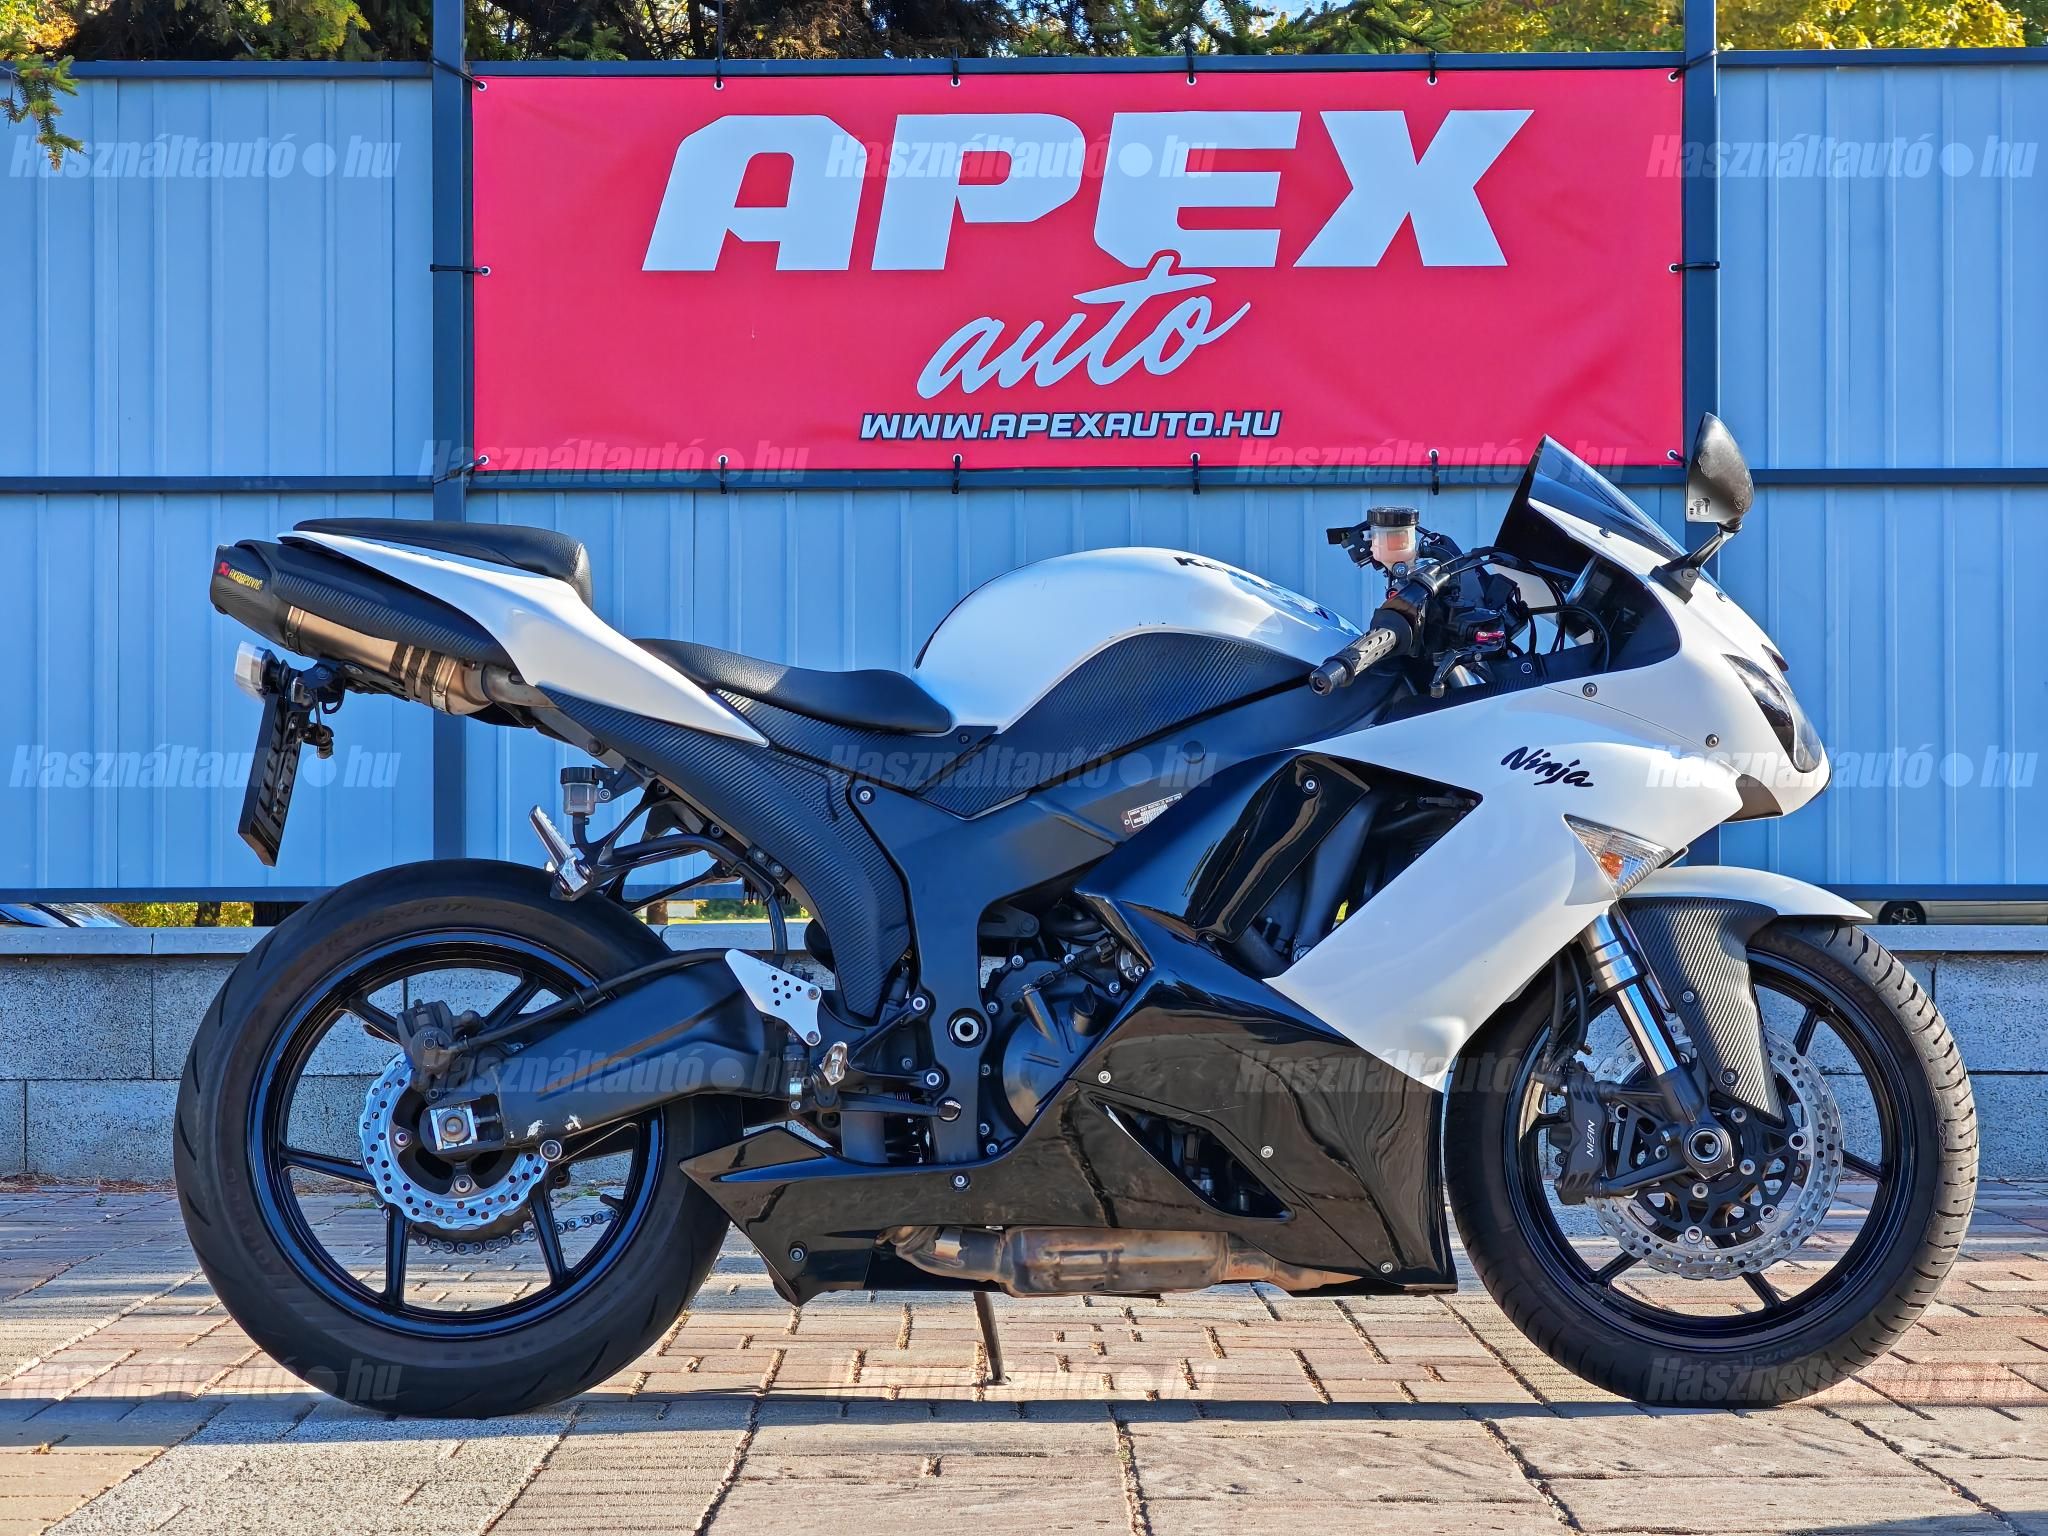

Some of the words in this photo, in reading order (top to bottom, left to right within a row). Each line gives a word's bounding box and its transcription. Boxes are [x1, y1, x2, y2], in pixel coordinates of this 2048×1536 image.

[642, 109, 1532, 272] APEX
[917, 255, 1251, 398] auto
[860, 411, 1282, 439] WWW.APEXAUTO.HU
[1501, 746, 1594, 787] Ninja
